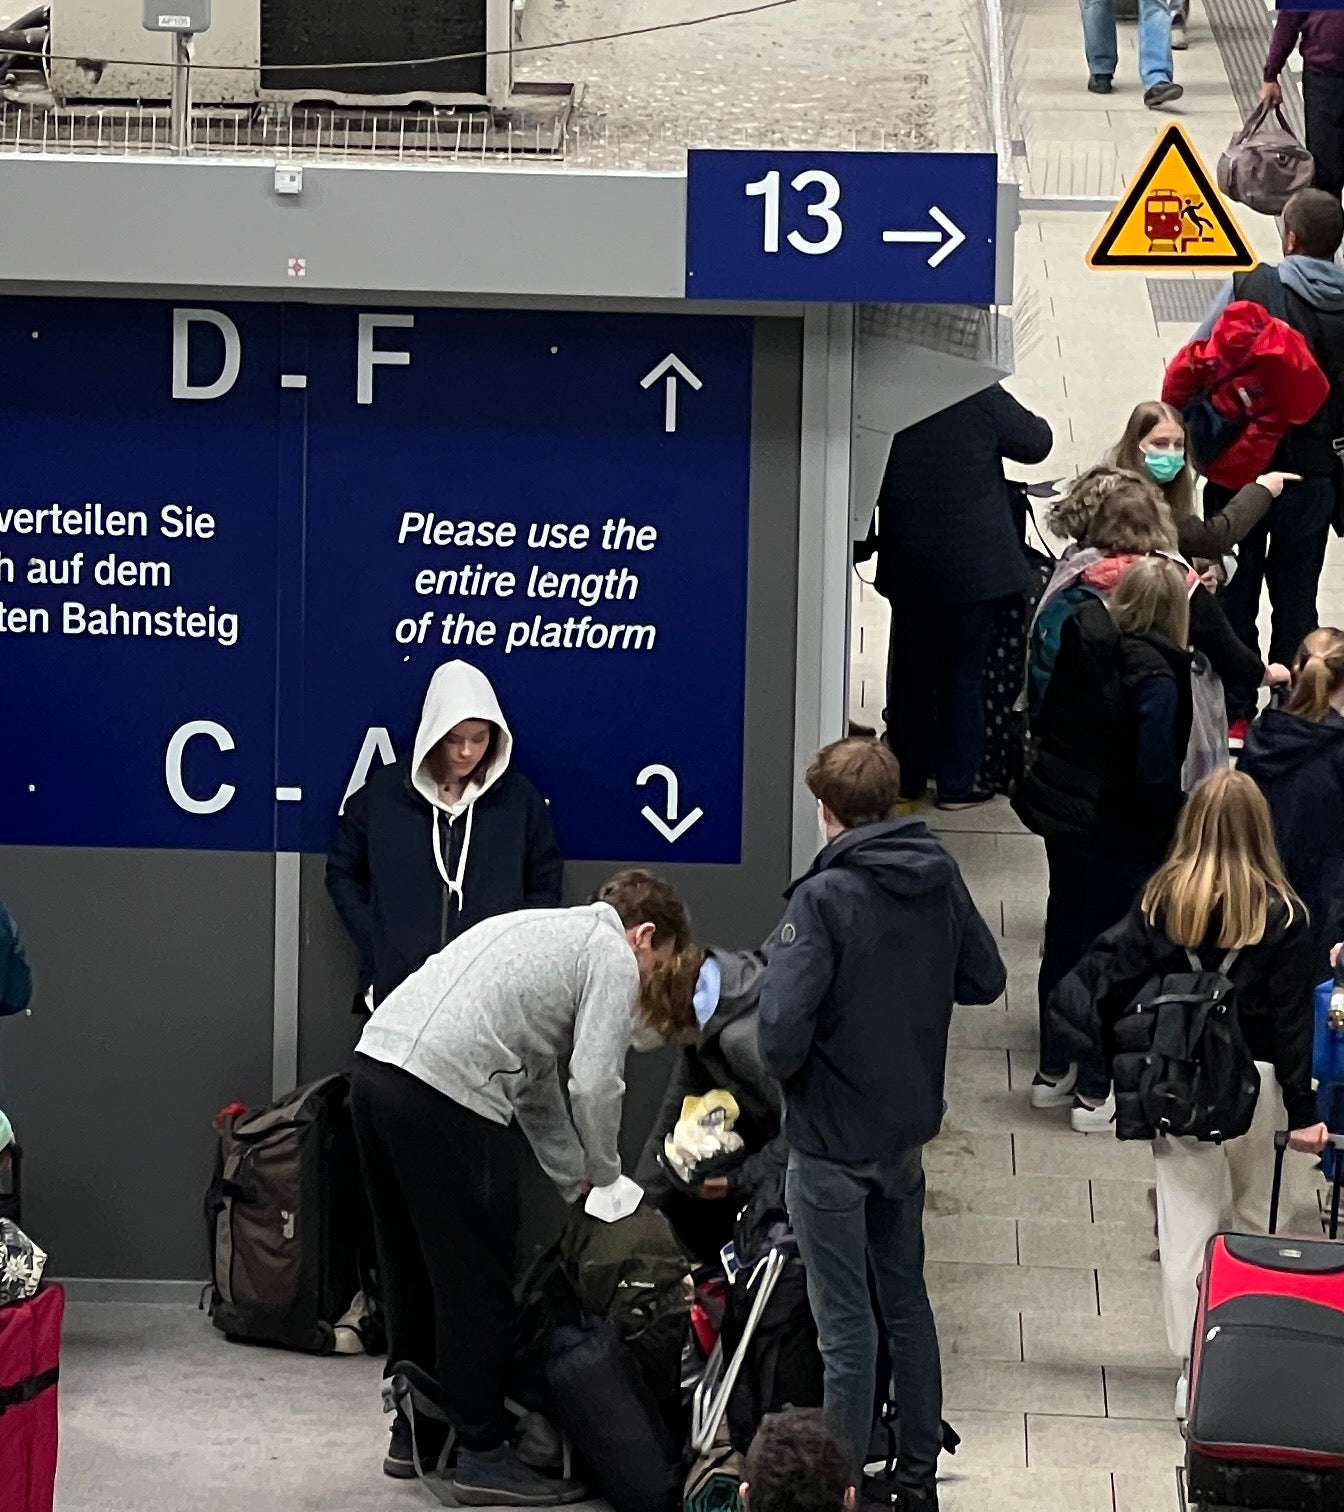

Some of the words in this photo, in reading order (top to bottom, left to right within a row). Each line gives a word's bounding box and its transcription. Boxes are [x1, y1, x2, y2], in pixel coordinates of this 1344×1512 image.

[745, 169, 843, 255] 13
[172, 308, 241, 400] D
[281, 374, 307, 388] -
[357, 313, 415, 404] F
[160, 505, 216, 538] Sie
[398, 511, 517, 547] Please
[527, 523, 590, 549] use
[601, 517, 657, 551] the
[26, 552, 84, 585] auf
[94, 553, 171, 587] dem
[414, 563, 516, 597] entire
[526, 565, 638, 607] length
[62, 602, 239, 646] Bahnsteig
[395, 611, 434, 644] of
[441, 612, 497, 646] the
[505, 615, 657, 653] platform
[165, 720, 236, 814] C
[275, 787, 302, 801] -
